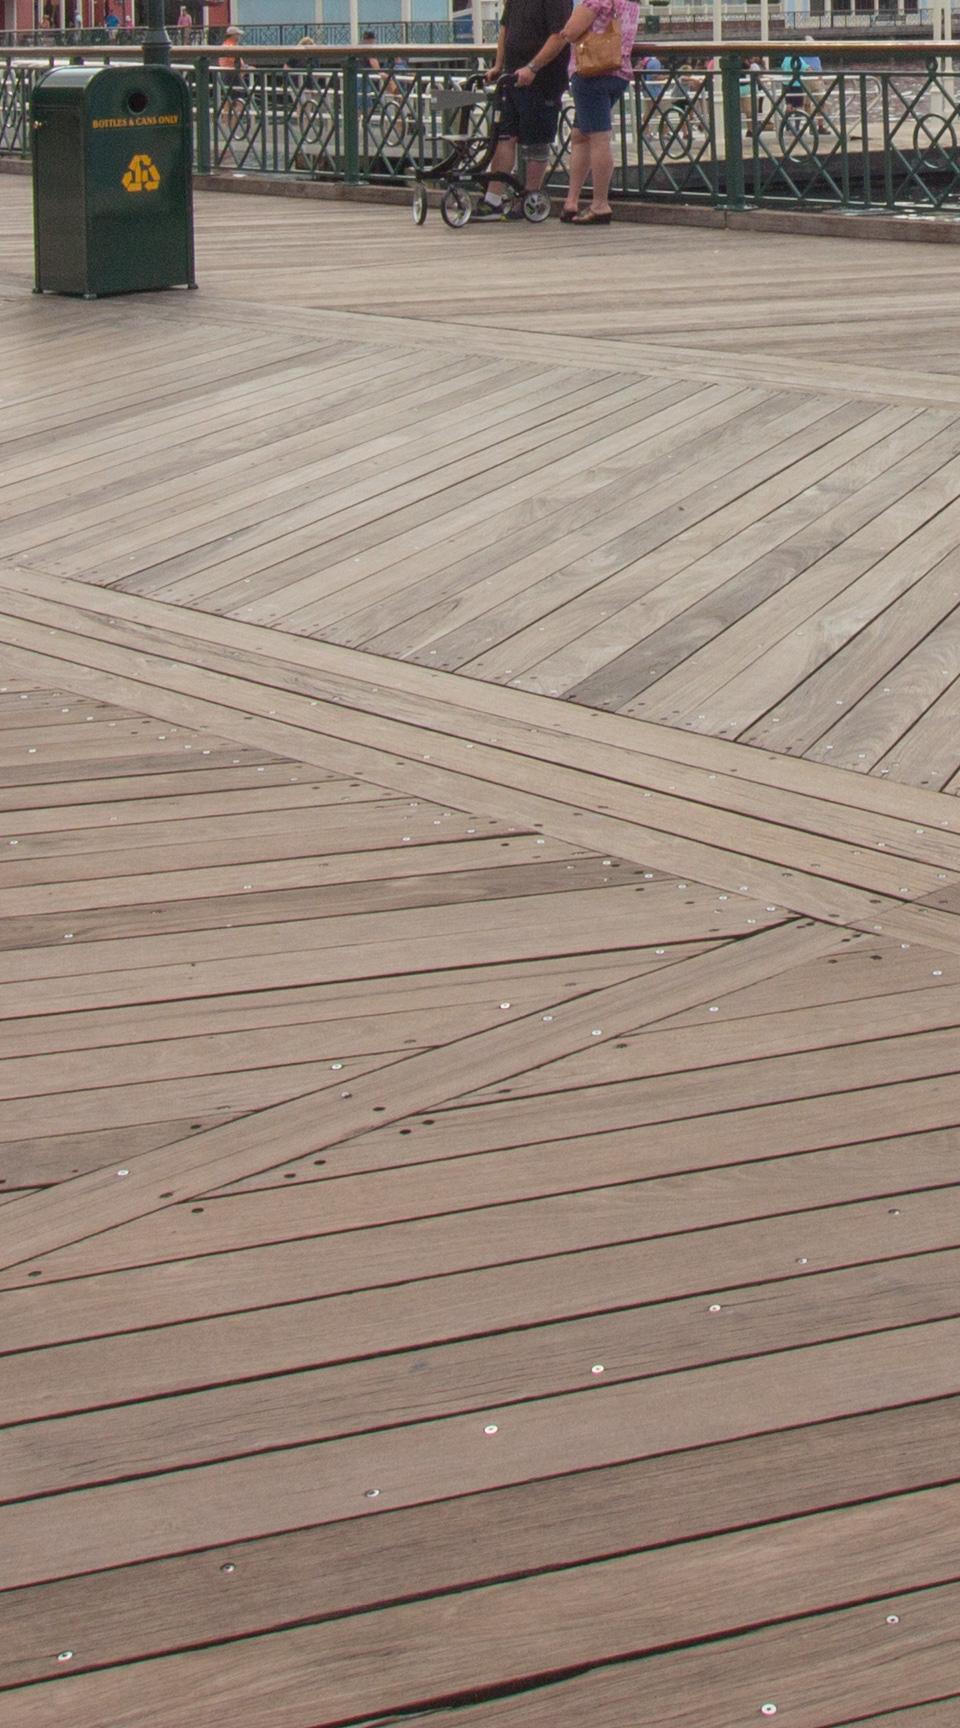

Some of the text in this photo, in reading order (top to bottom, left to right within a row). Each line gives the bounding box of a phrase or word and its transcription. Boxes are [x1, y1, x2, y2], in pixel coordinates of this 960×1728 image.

[92, 115, 178, 129] BOTTLES & CANS ONLY
